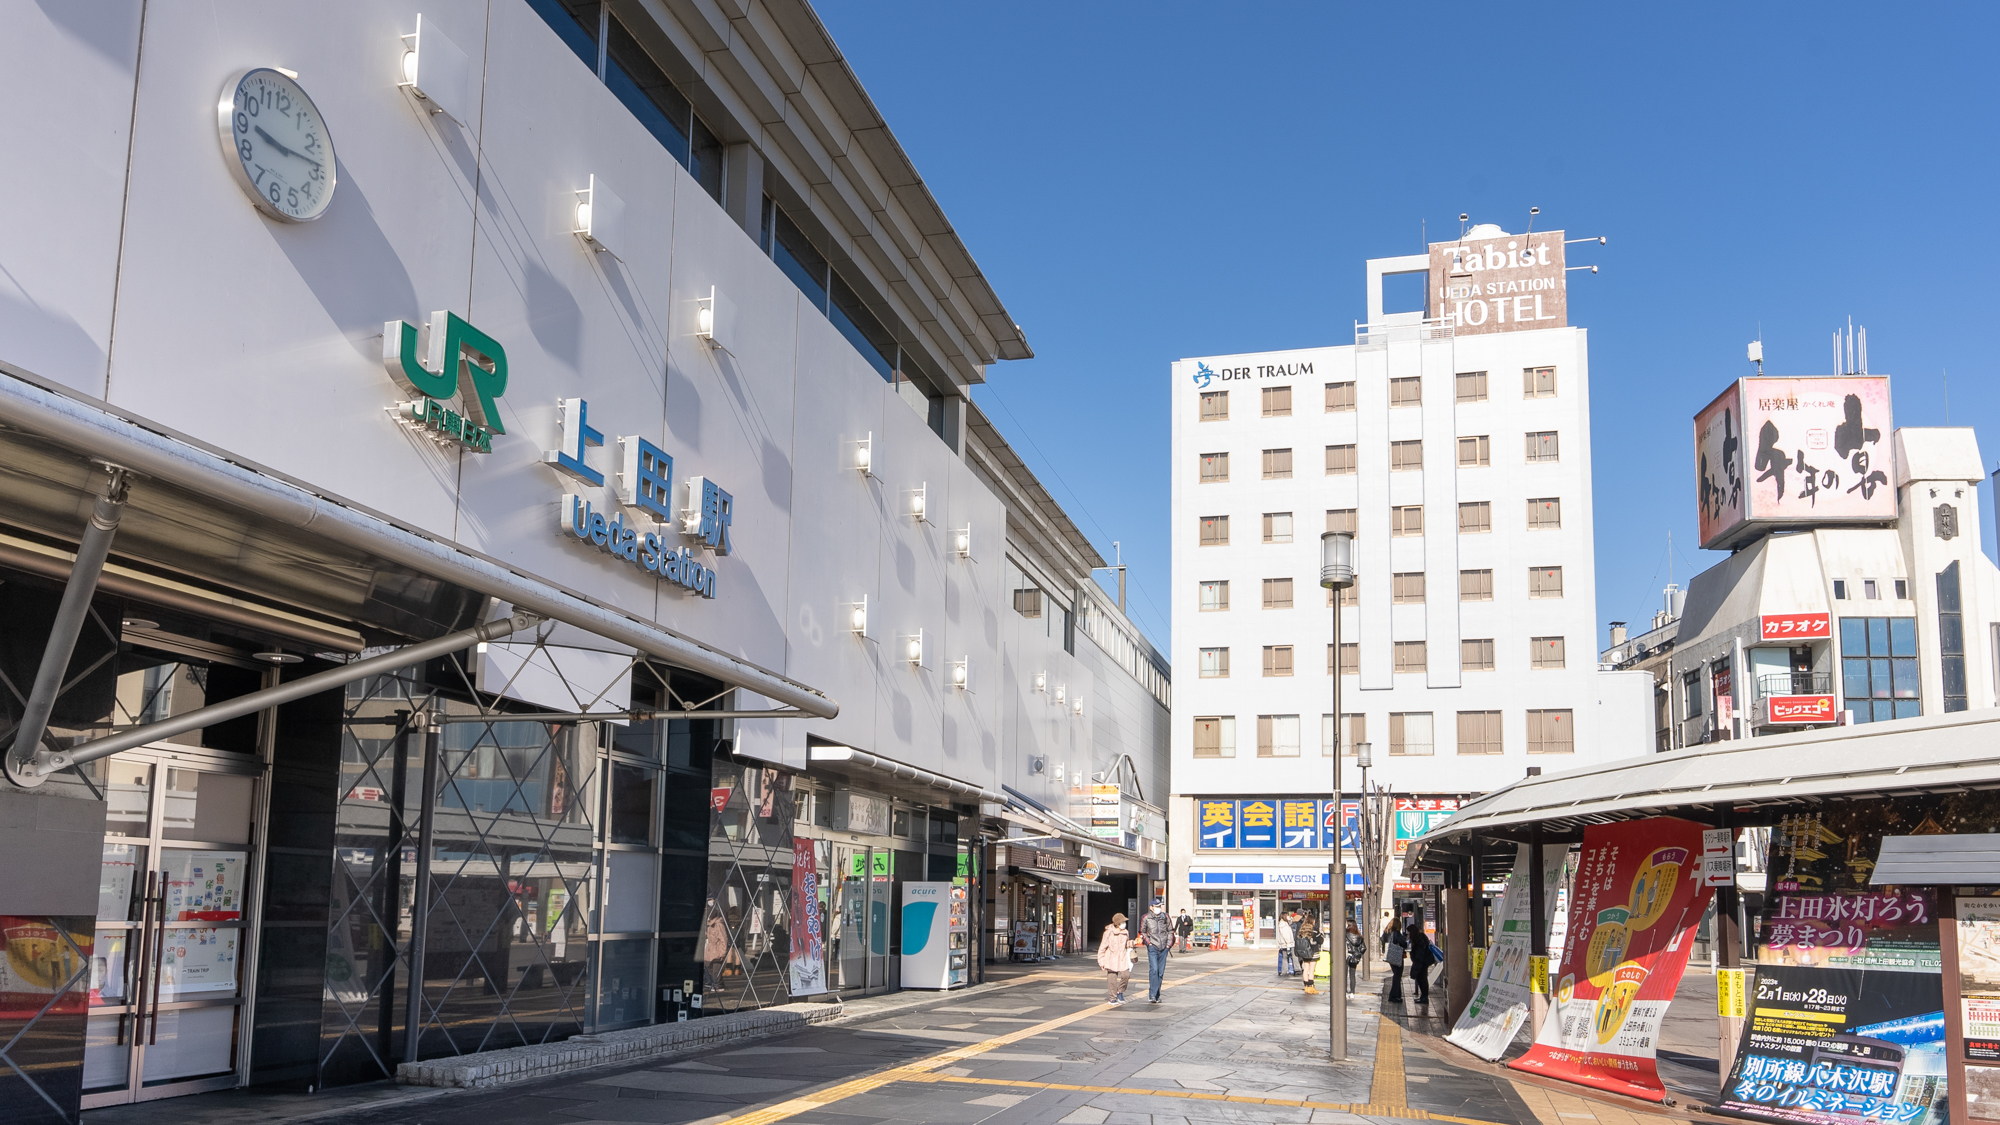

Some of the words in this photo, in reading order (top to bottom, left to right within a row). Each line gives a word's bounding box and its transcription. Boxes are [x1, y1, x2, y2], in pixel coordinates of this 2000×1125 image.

[243, 91, 260, 118] 10
[259, 85, 272, 110] 11
[275, 90, 291, 118] 12
[236, 112, 249, 134] 9
[296, 111, 302, 131] 1
[240, 138, 253, 162] 8
[304, 132, 316, 156] 2
[254, 163, 266, 186] 7
[308, 162, 320, 182] 3
[269, 181, 281, 204] 6
[287, 186, 299, 209] 5
[300, 181, 312, 200] 4
[1442, 240, 1552, 274] Tabist
[1439, 283, 1482, 299] UEDA
[1486, 276, 1556, 296] STATION
[1439, 294, 1557, 328] HOTEL
[392, 309, 509, 436] JR
[1221, 366, 1251, 382] DER
[1256, 362, 1314, 379] TRAUM
[404, 397, 493, 454] JR東日本
[549, 397, 734, 557] 上田駅
[564, 493, 638, 563] Ueda
[642, 531, 716, 600] Station
[1764, 619, 1828, 634] カラオケ
[1773, 704, 1830, 716] ビッグエコー
[1202, 801, 1315, 828] 英会話
[1322, 802, 1358, 826] 2F
[1203, 827, 1354, 849] イーオン
[1051, 857, 1066, 871] COFFEE
[1662, 852, 1676, 861] もらう
[1705, 860, 1732, 873] バス乗降場所
[1269, 874, 1317, 883] LAWSON
[1412, 872, 1420, 882] 4
[1603, 846, 1619, 891] それは
[911, 887, 937, 896] acure
[1776, 882, 1798, 891] 第4回
[804, 871, 822, 962] おみやげ
[1563, 848, 1597, 965] コミュニティ通貨
[1606, 912, 1620, 920] つかう
[1771, 894, 1925, 924] 上田氷灯ろう
[1769, 923, 1864, 953] 夢まつり
[1538, 956, 1546, 993] 足もと注意
[1620, 970, 1641, 980] たのしむ
[1734, 970, 1743, 1017] 足もと注意
[1631, 1006, 1658, 1018] 無料で使える
[1618, 1036, 1650, 1049] コミュニティ通貨
[1743, 1056, 1896, 1097] 別所線八木沢駅
[1736, 1079, 1923, 1122] 冬のイルミネーション
